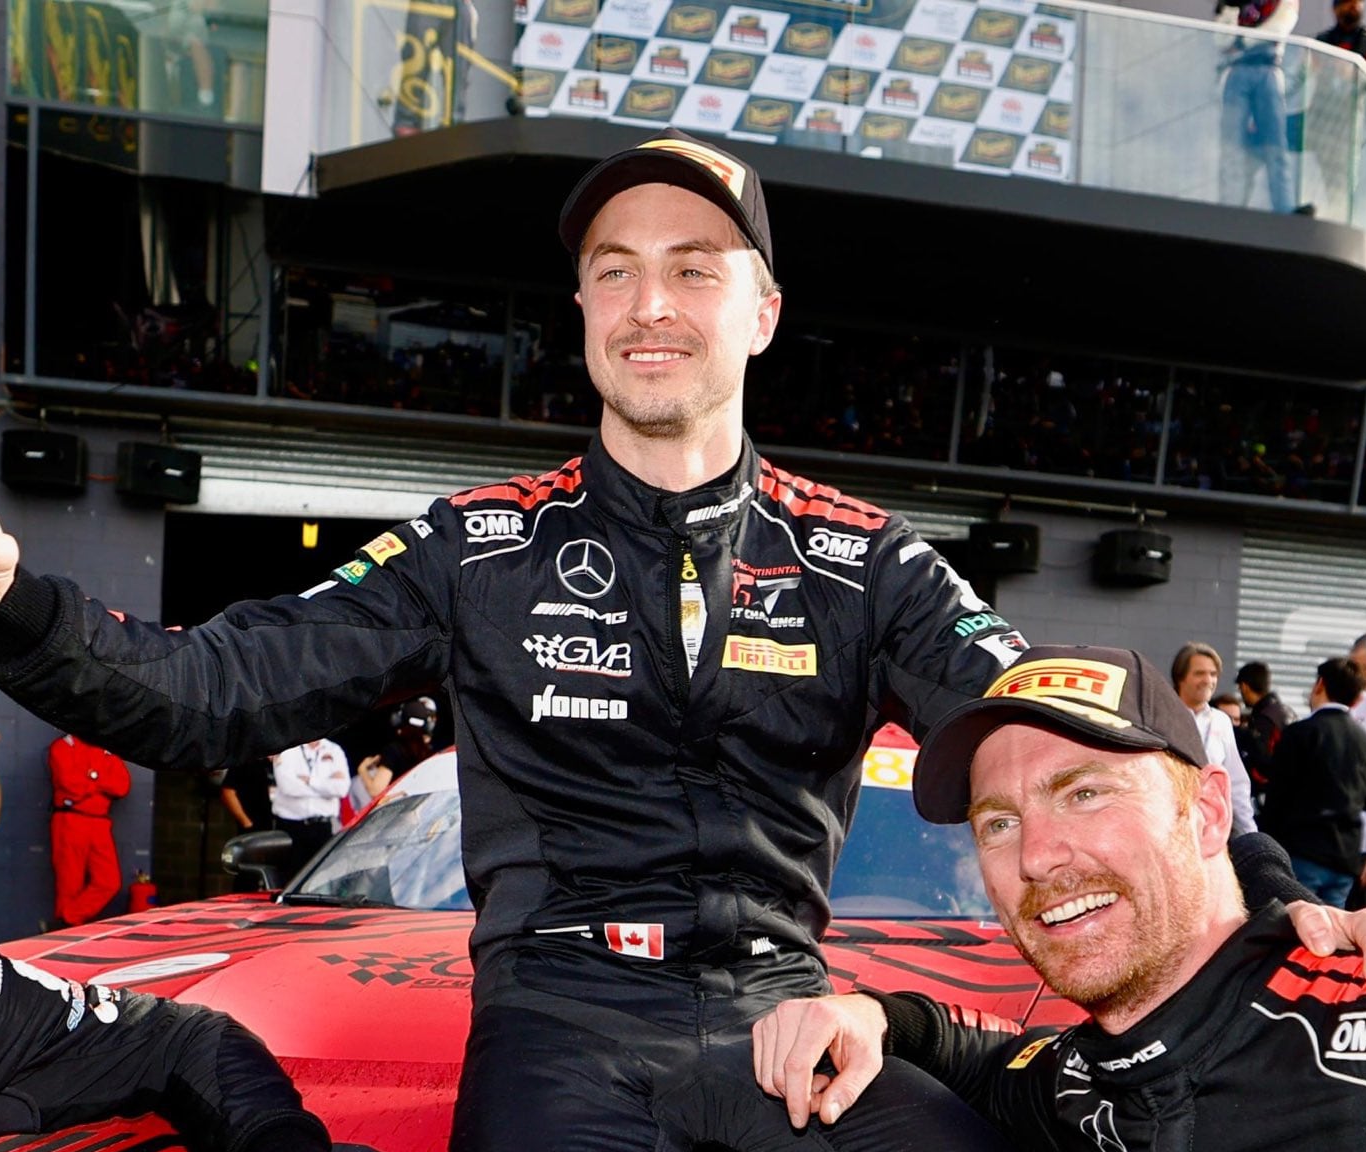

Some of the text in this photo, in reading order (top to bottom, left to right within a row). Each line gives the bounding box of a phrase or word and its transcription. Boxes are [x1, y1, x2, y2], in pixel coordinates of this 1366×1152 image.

[465, 514, 524, 537] OMP
[808, 533, 869, 561] OMP
[565, 604, 628, 625] AMG
[730, 641, 809, 671] PIRELLI
[1109, 1040, 1168, 1072] AMG
